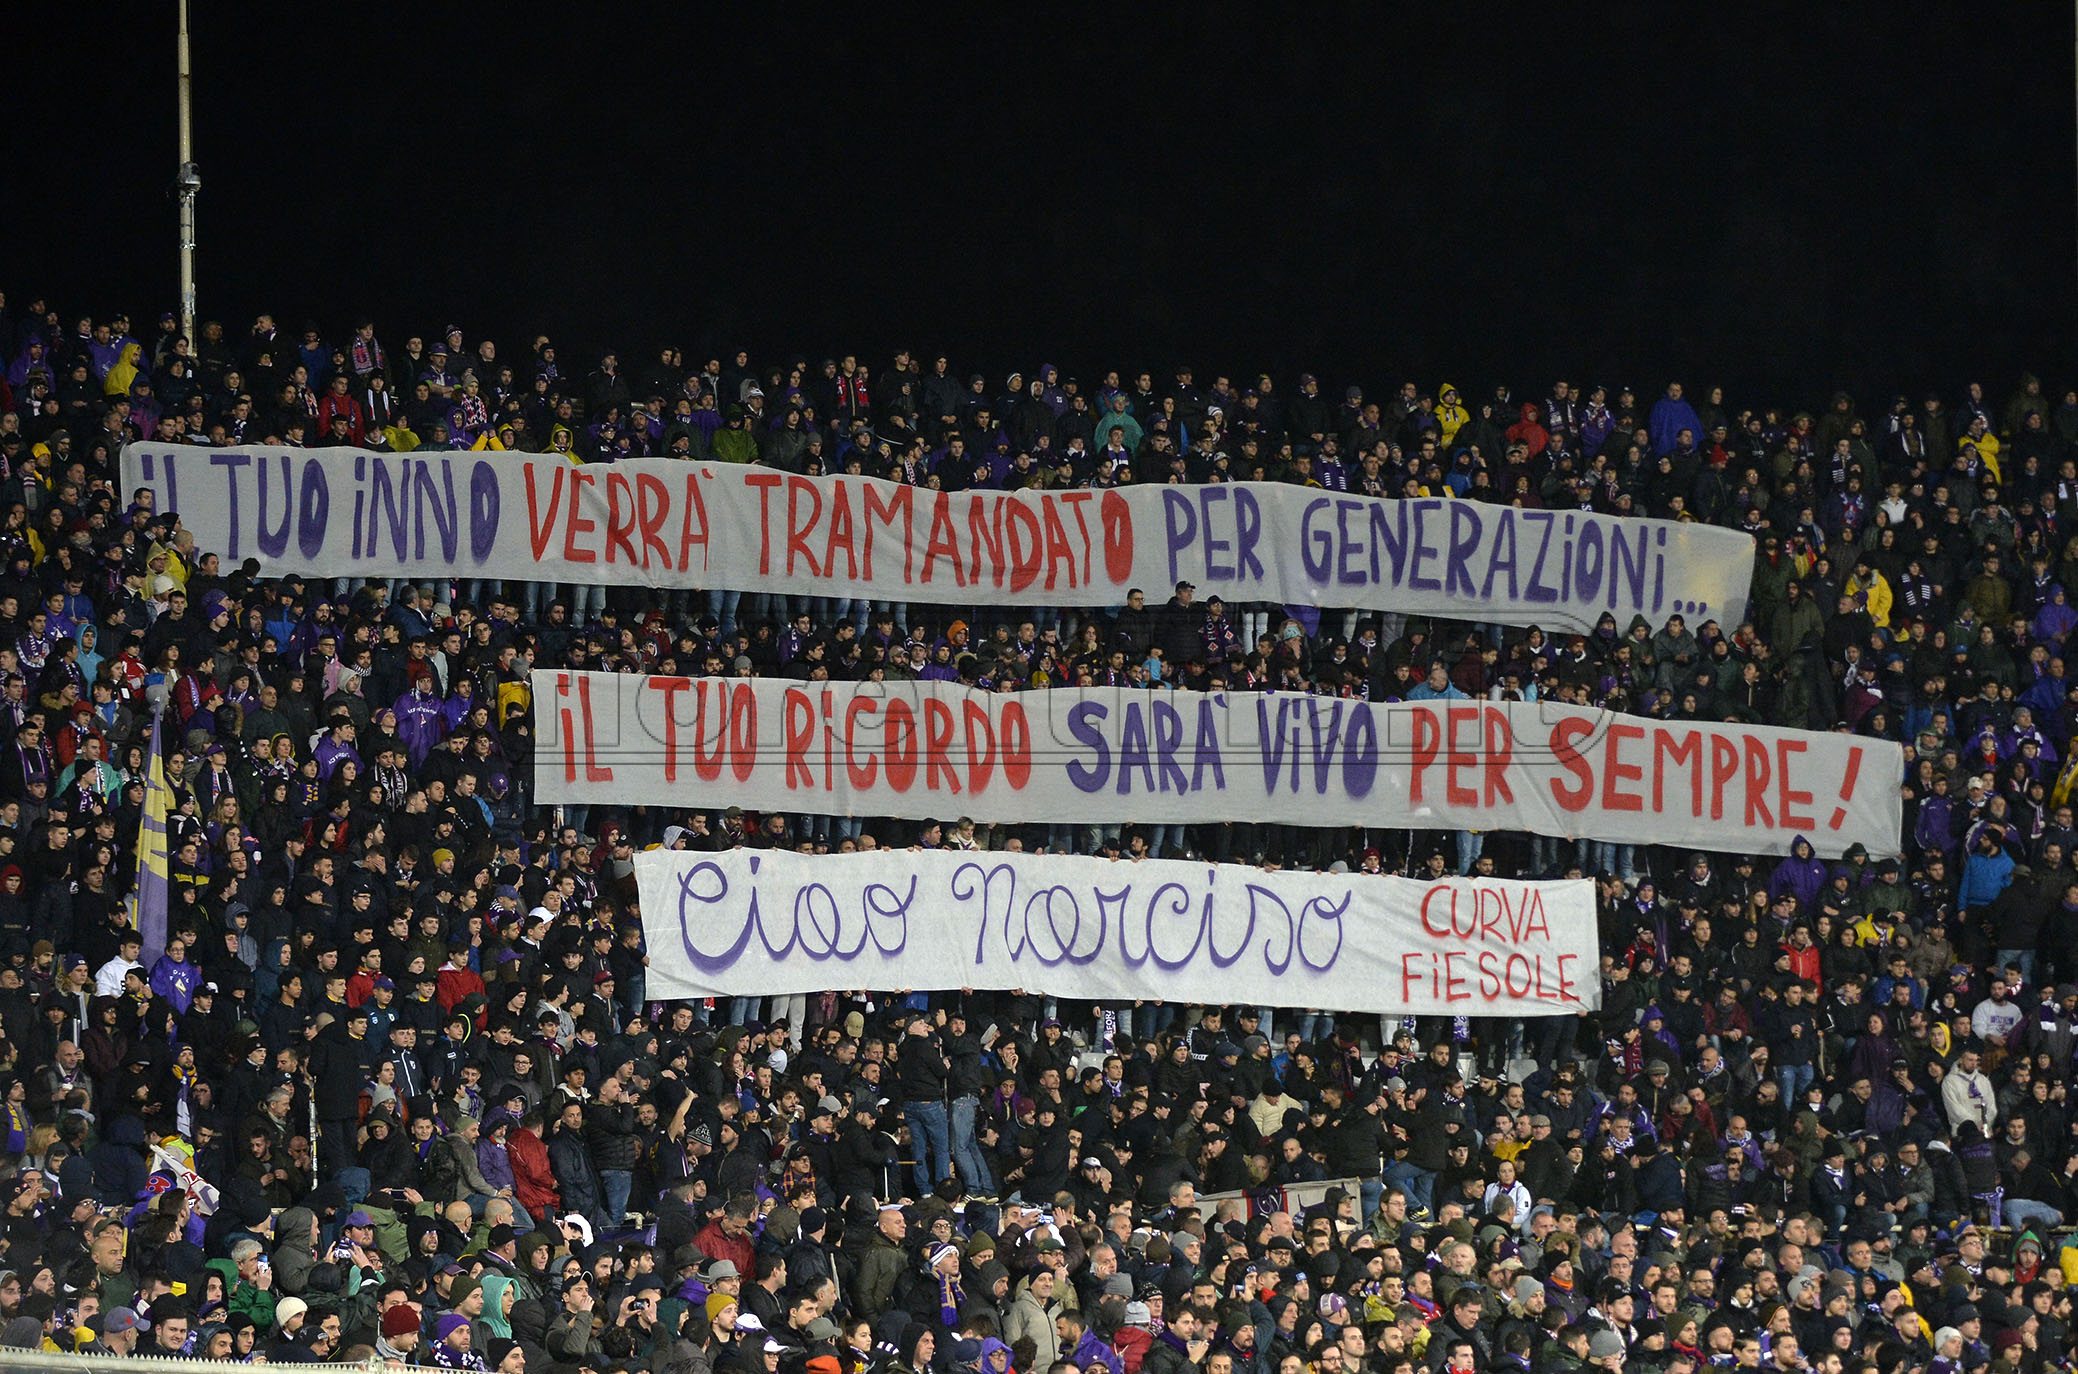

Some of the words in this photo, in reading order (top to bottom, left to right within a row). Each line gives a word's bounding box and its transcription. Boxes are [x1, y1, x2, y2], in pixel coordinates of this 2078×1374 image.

[211, 455, 329, 561] TUO
[744, 474, 1134, 593] TRAMANDATO
[1164, 487, 1265, 585] PER
[648, 676, 758, 784] TUO
[1410, 706, 1514, 807] PER
[677, 856, 917, 976] Ciao
[1420, 884, 1551, 945] CURVA
